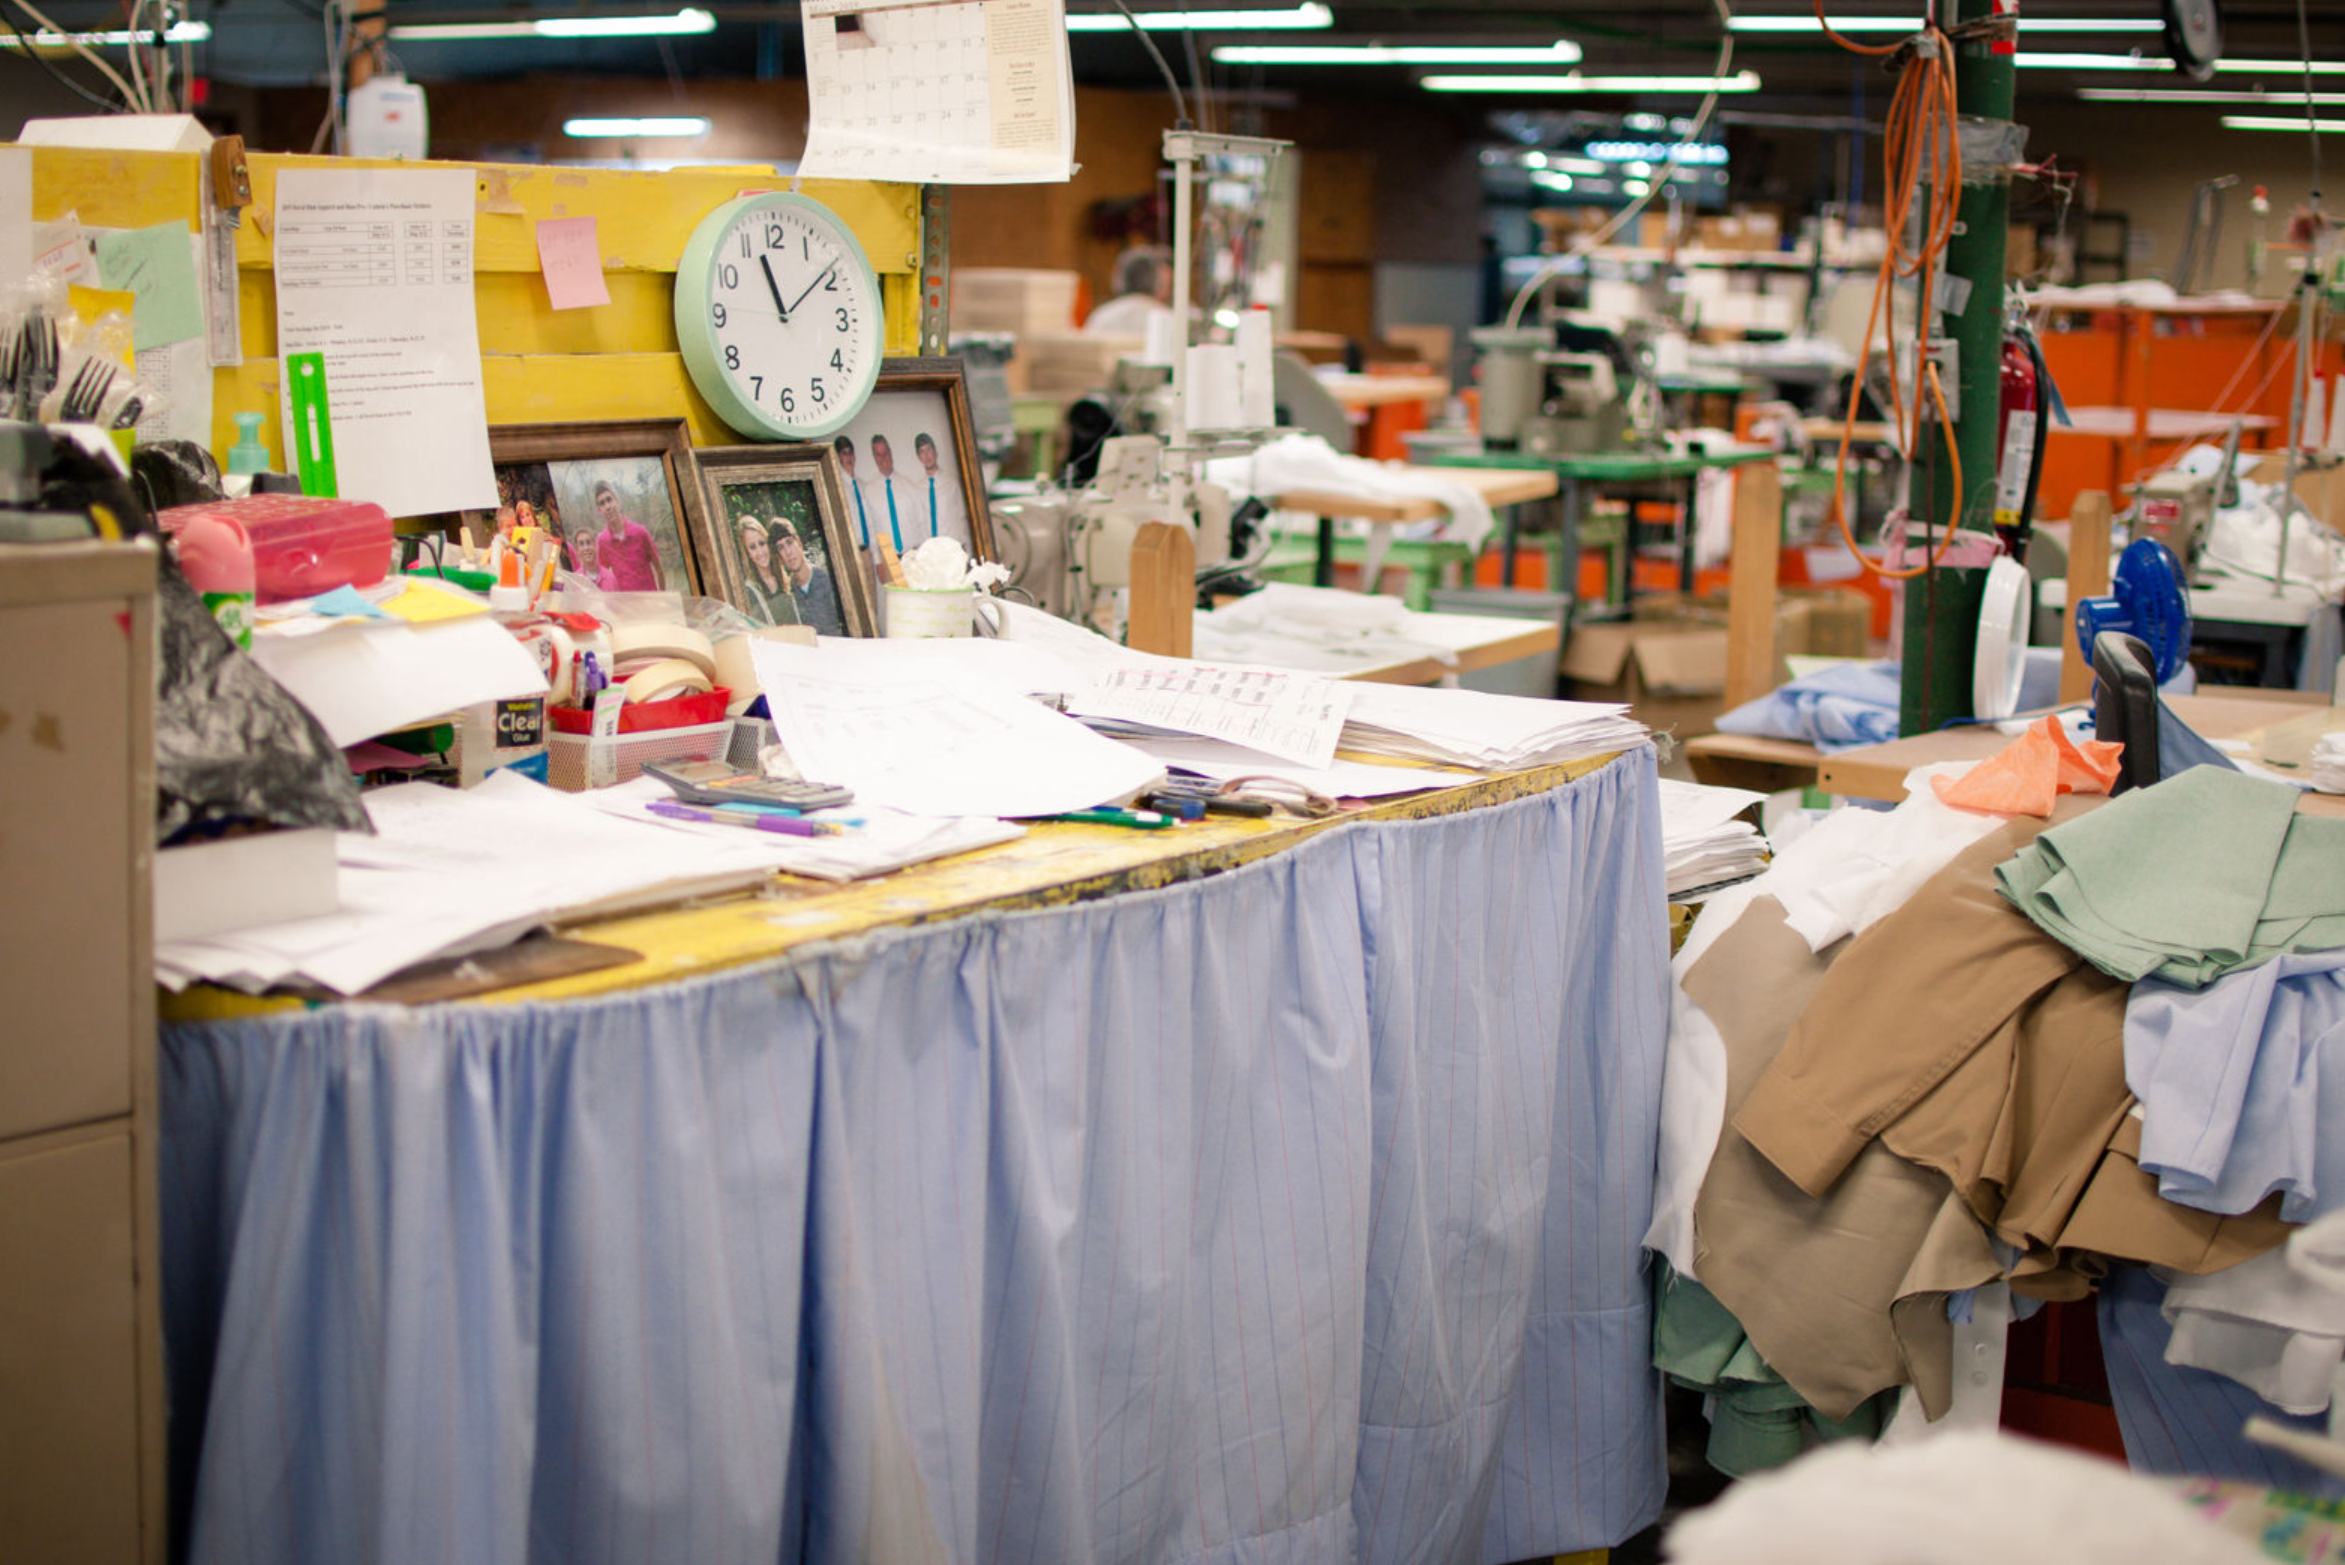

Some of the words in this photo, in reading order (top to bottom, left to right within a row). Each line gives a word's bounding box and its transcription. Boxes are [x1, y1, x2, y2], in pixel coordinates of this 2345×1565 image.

[740, 233, 752, 259] 11
[765, 224, 785, 250] 12
[802, 236, 809, 261] 1
[717, 263, 739, 290] 10
[824, 269, 838, 292] 2
[712, 303, 727, 328] 9
[835, 308, 849, 332] 3
[725, 345, 740, 371] 8
[830, 348, 844, 373] 4
[750, 376, 764, 401] 7
[780, 387, 795, 413] 6
[810, 377, 825, 402] 5
[497, 712, 541, 733] Clear
